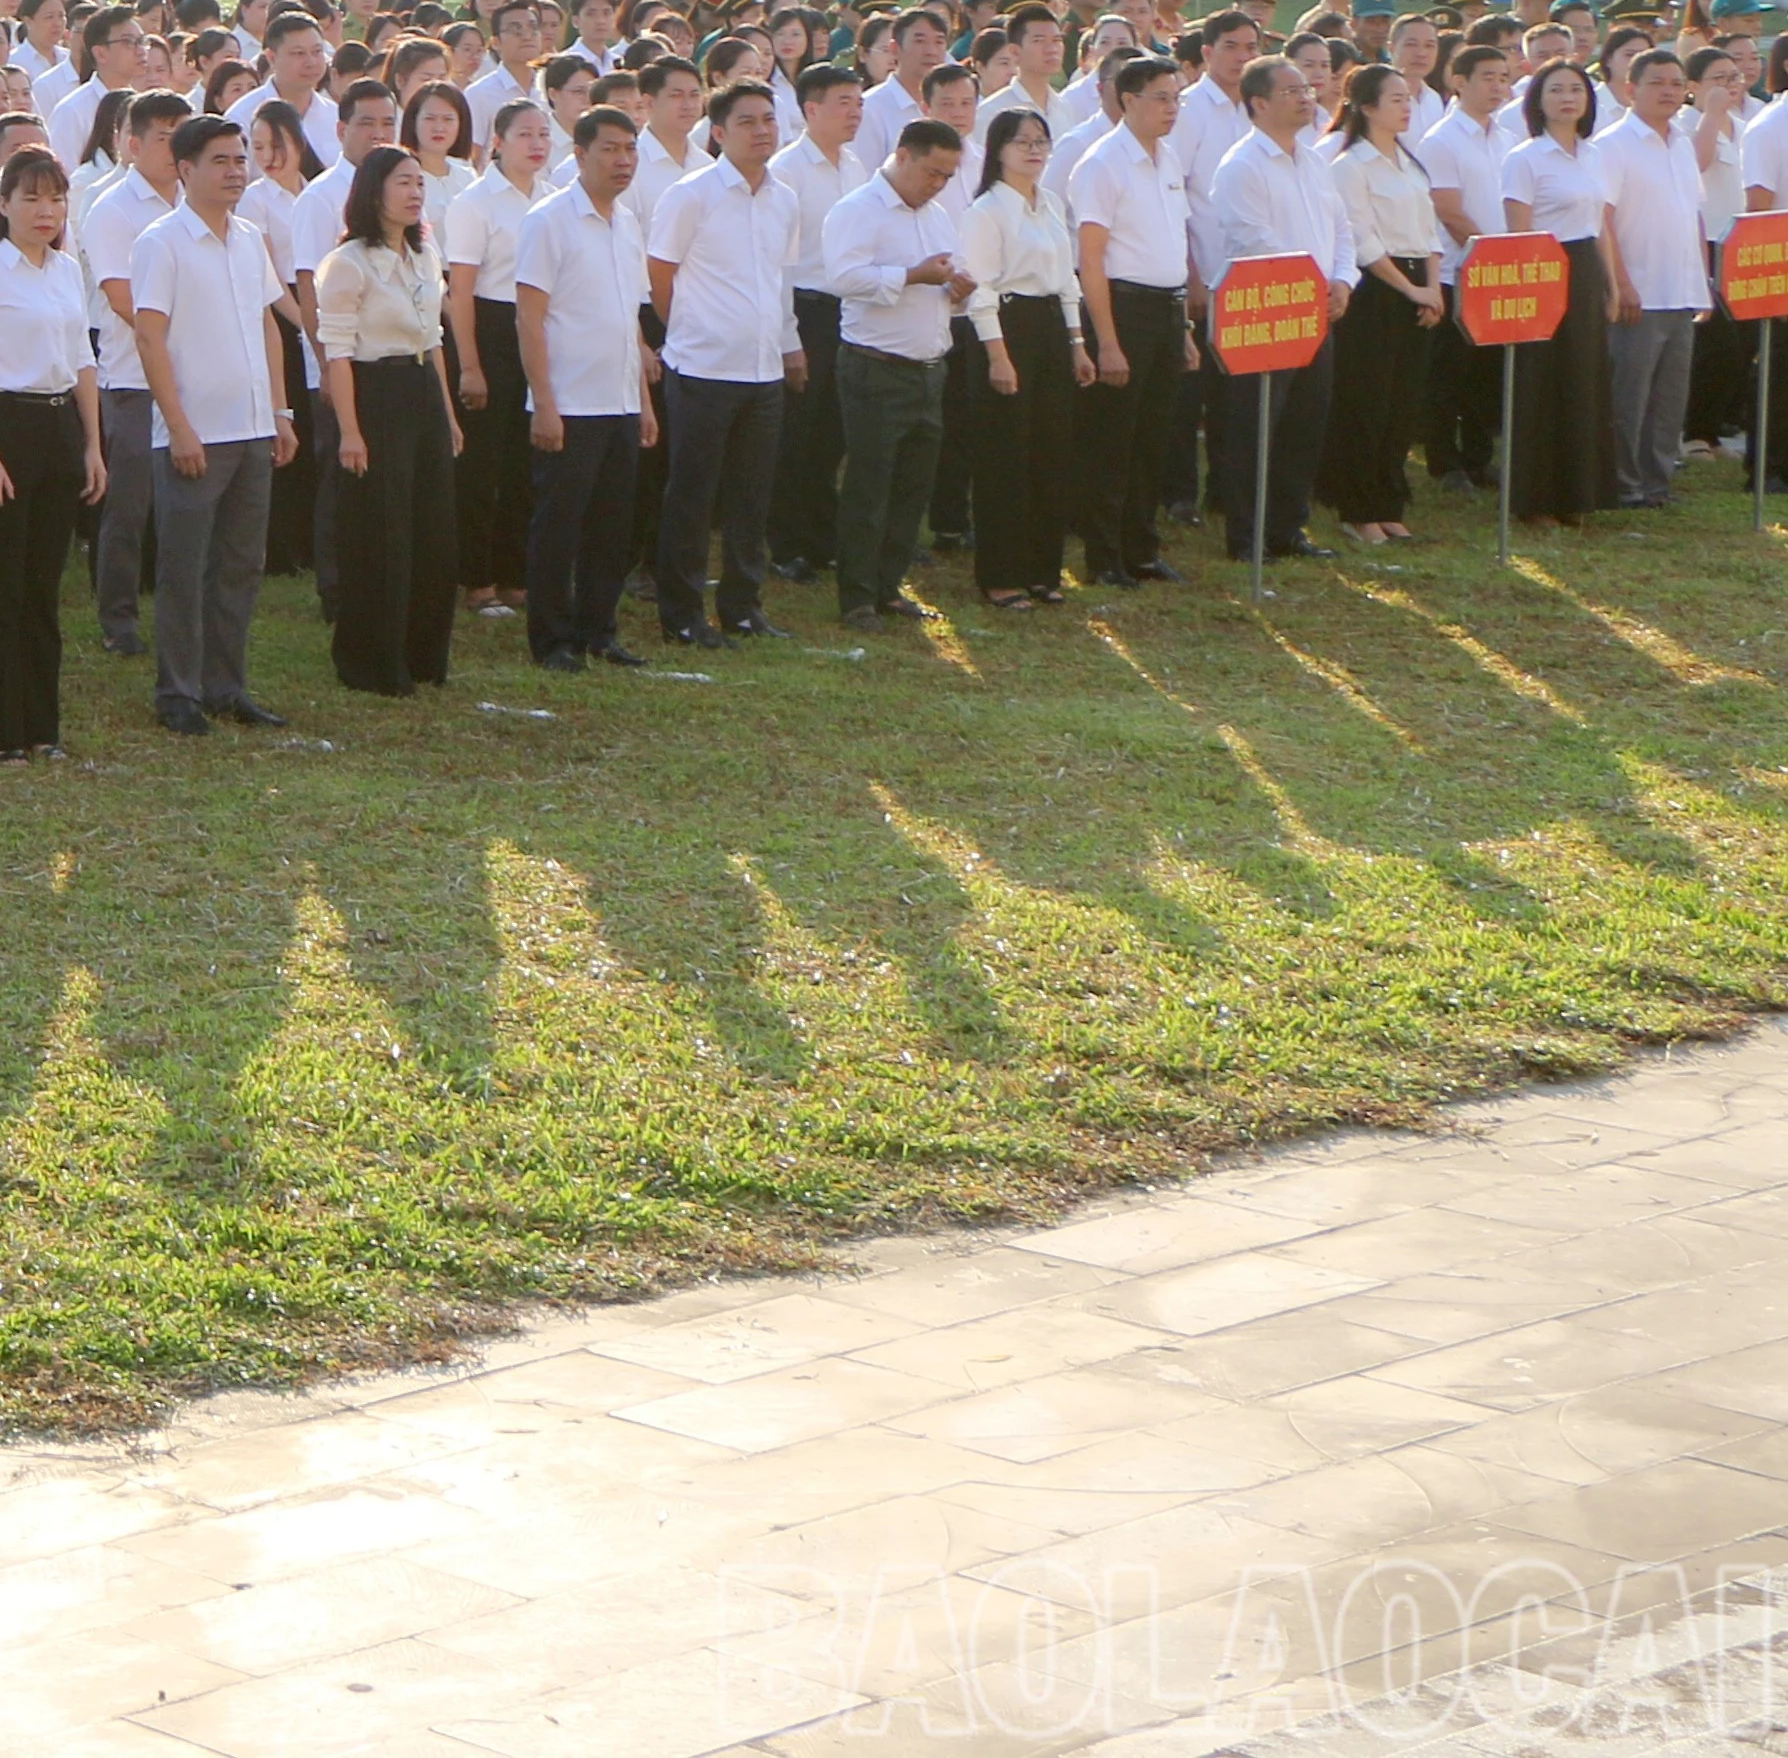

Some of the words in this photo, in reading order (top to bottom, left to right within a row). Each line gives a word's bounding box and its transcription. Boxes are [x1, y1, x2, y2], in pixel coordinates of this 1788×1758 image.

[1481, 261, 1500, 287] VĂN
[1522, 253, 1538, 284] THỂ
[1539, 261, 1561, 283] THAO
[1224, 284, 1245, 313] CÁN
[1264, 280, 1290, 308] CÔNG
[1290, 275, 1316, 305] CHỨC
[1490, 293, 1502, 320] VÀ
[1503, 298, 1517, 320] DU
[1517, 297, 1537, 323] LỊCH
[1220, 317, 1243, 349] KHỐI
[1274, 313, 1300, 342] ĐOÀN
[1301, 305, 1318, 338] THỂ
